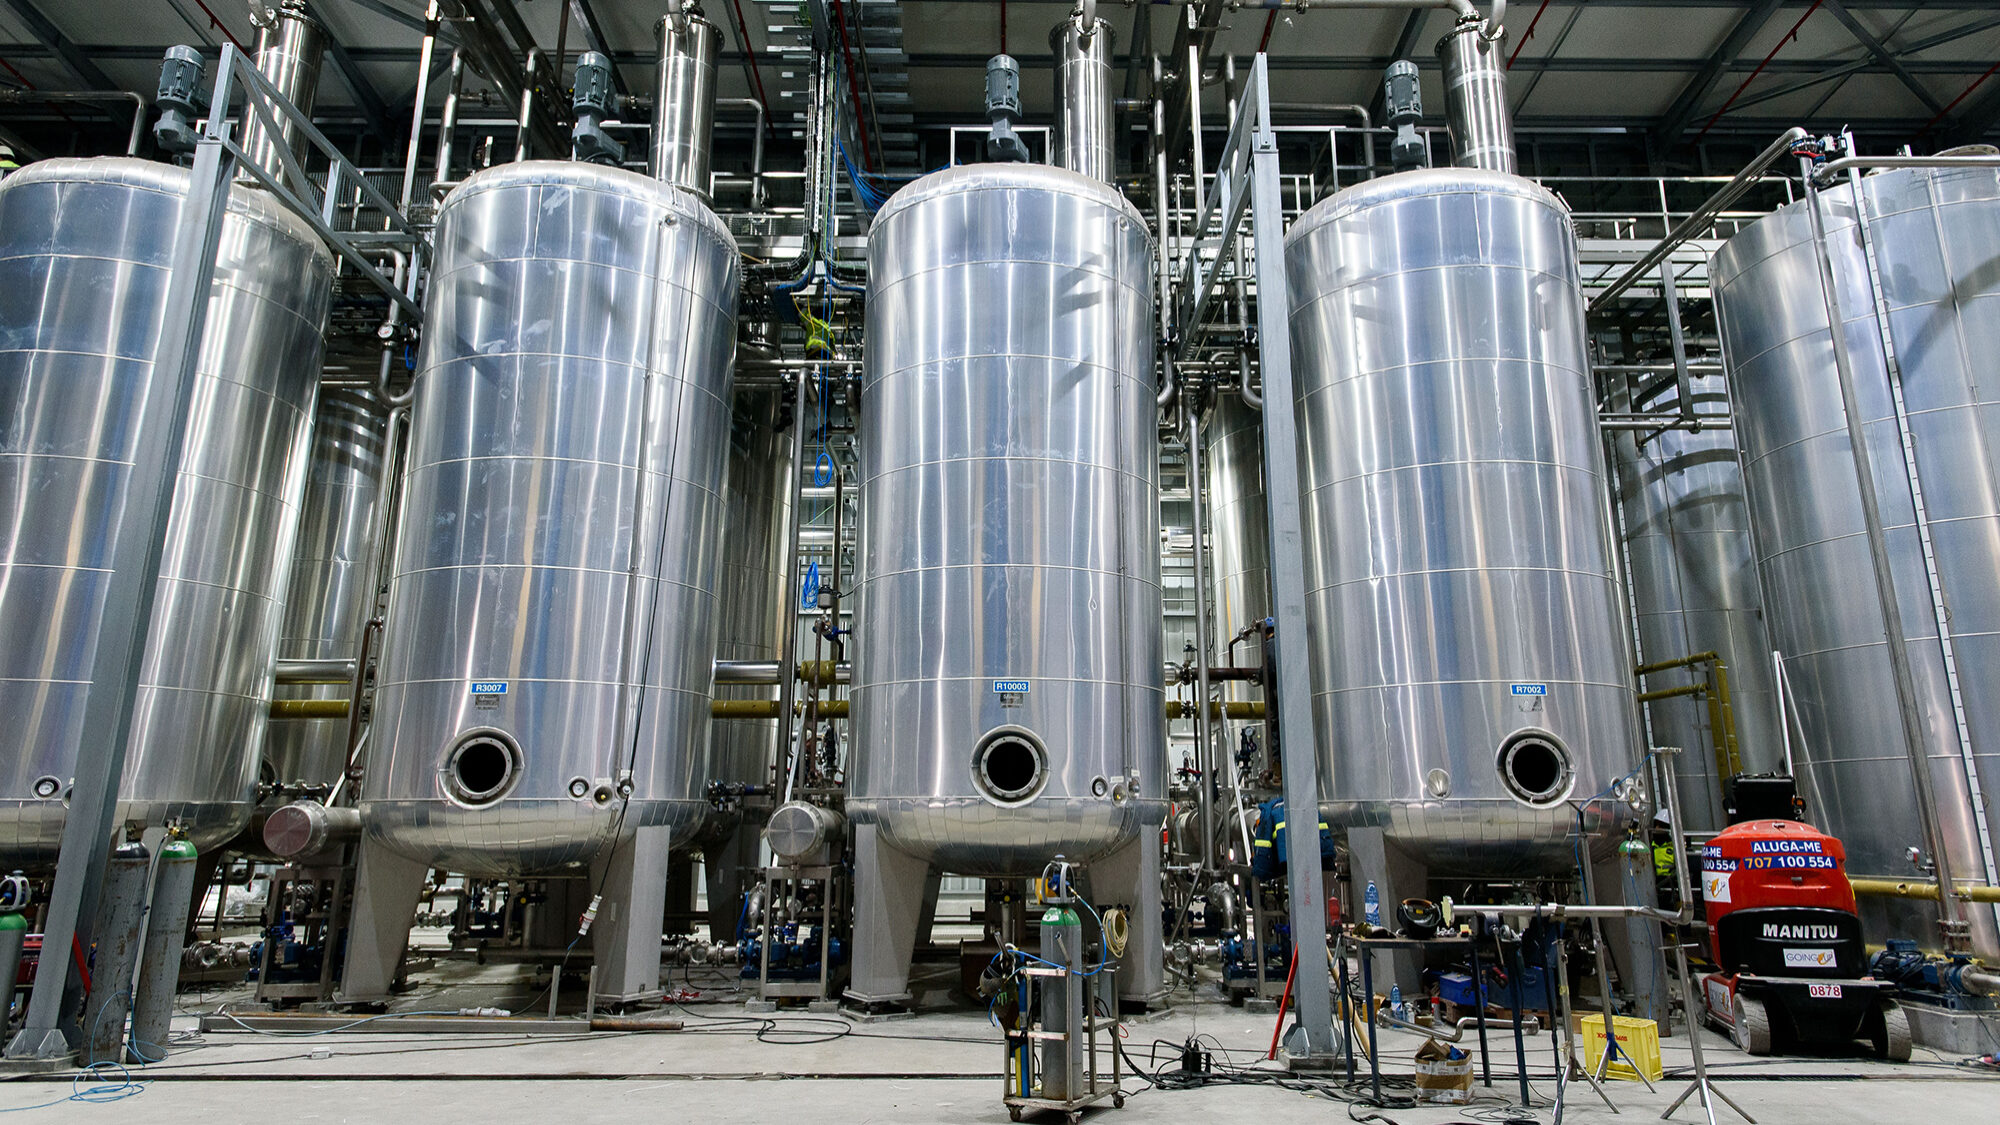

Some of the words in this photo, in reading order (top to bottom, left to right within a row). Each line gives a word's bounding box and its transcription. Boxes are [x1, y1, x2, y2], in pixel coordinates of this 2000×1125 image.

[476, 684, 502, 692] R3007
[1516, 686, 1542, 694] R7002
[1753, 841, 1822, 853] ALUGA-ME
[1716, 859, 1736, 871] 554
[1745, 857, 1772, 869] 707
[1778, 855, 1806, 868] 100
[1808, 856, 1833, 868] 554
[1763, 923, 1838, 939] MANITOU
[1786, 952, 1818, 962] GOING
[1810, 986, 1841, 997] 0878
